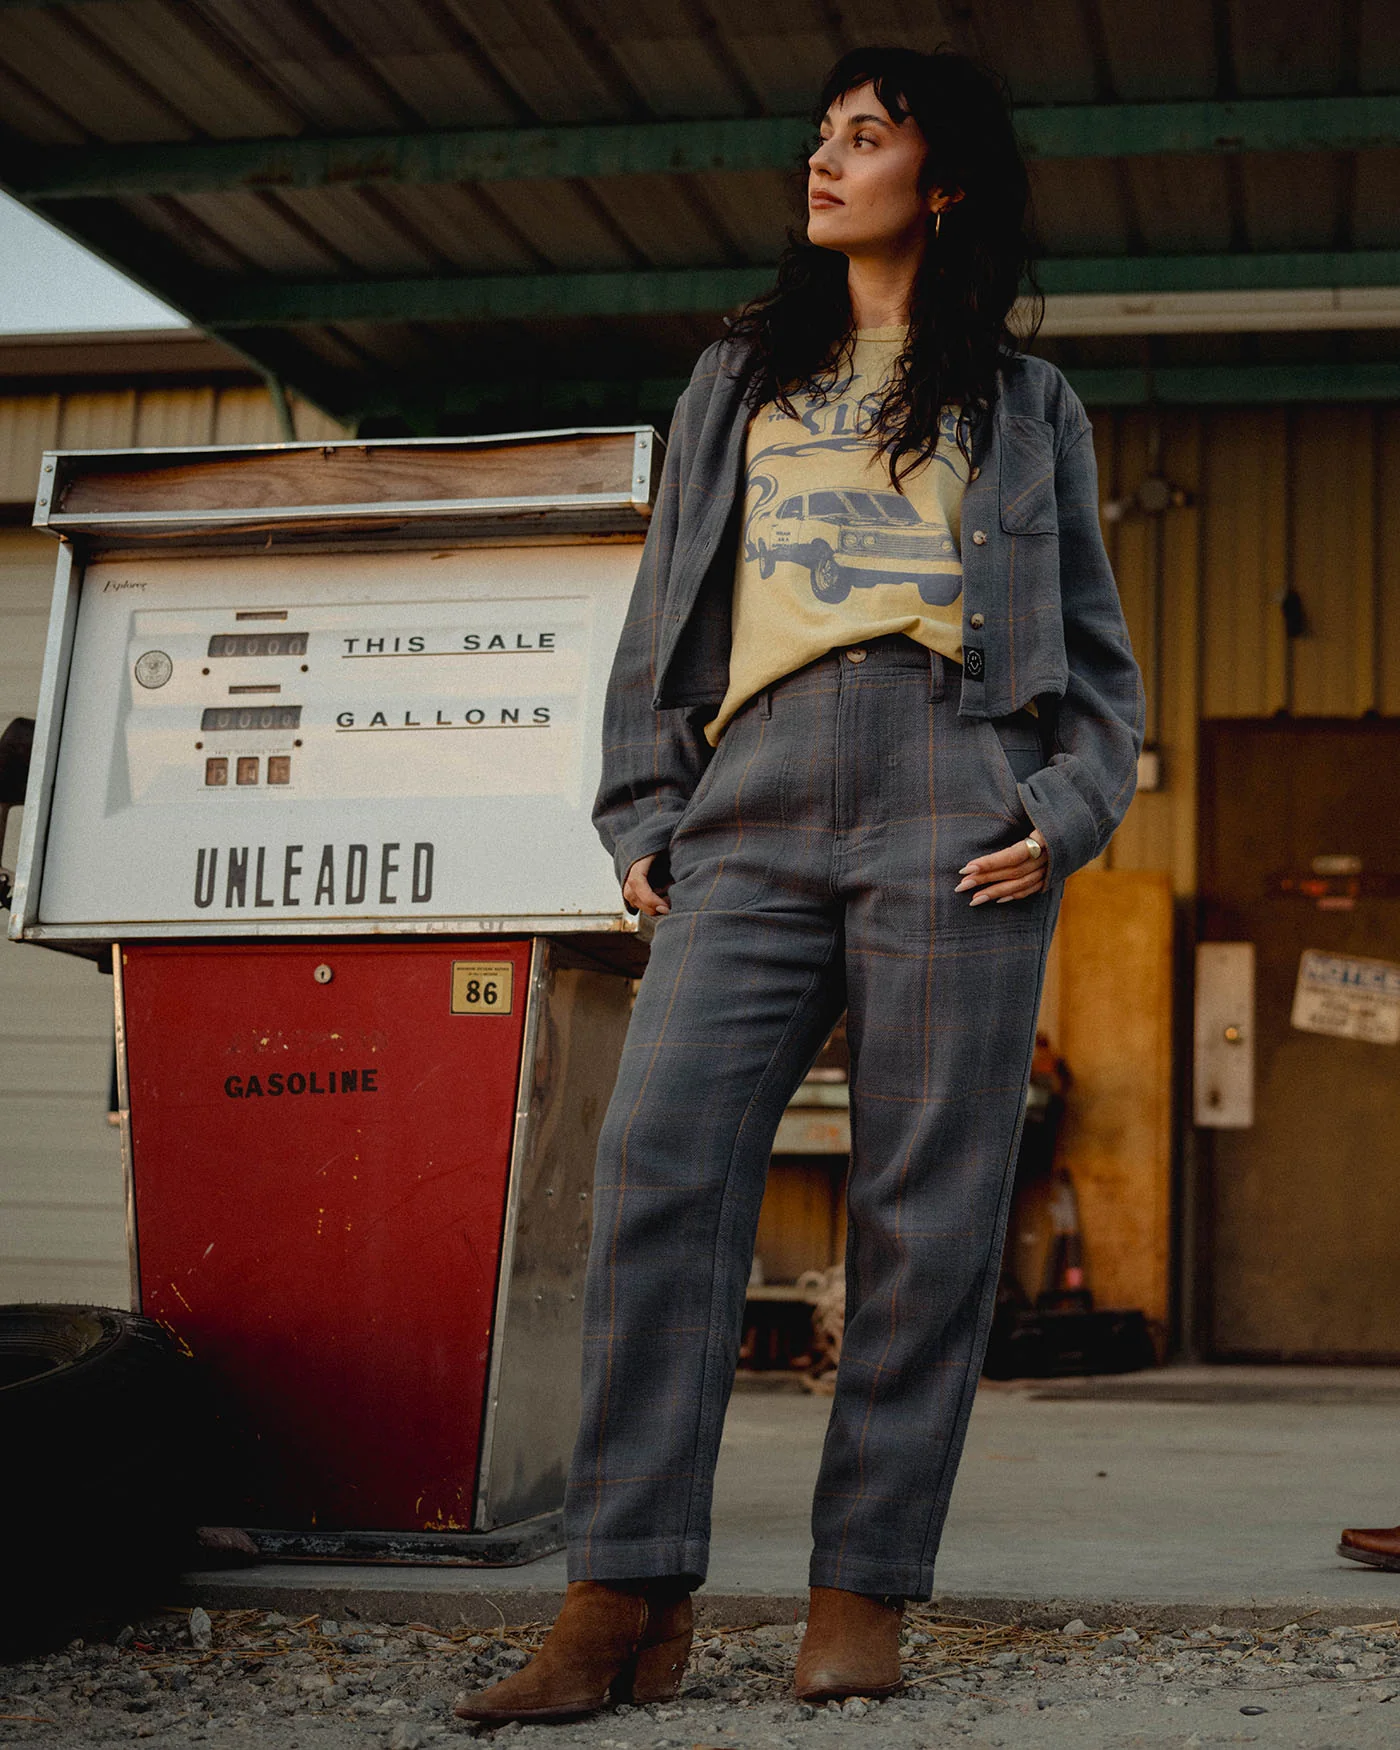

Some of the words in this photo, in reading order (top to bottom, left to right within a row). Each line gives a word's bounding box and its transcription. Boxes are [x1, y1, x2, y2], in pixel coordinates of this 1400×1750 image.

[344, 636, 426, 654] THIS
[463, 633, 556, 651] SALE
[336, 707, 551, 728] GALLONS
[194, 842, 435, 909] UNLEADED
[466, 980, 498, 1005] 86
[224, 1069, 378, 1099] GASOLINE
